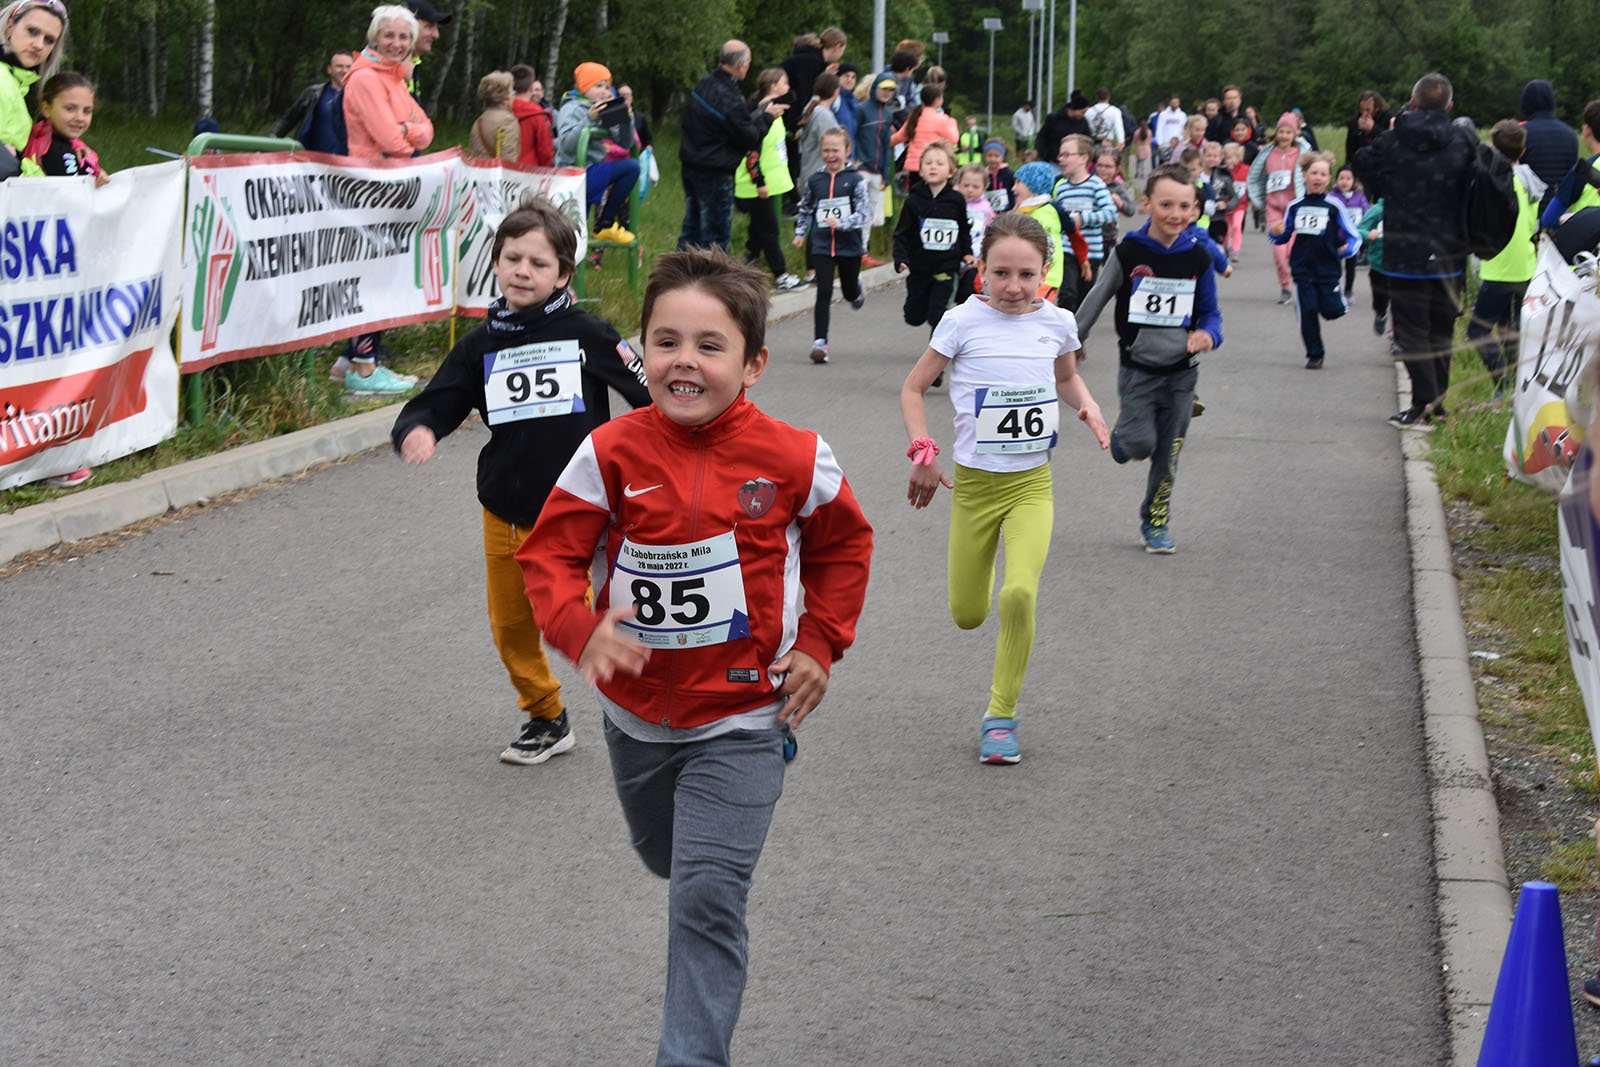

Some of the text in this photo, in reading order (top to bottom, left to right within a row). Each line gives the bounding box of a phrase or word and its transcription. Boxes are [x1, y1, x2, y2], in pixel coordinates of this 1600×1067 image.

[823, 207, 842, 219] 79
[1301, 216, 1318, 228] 18
[924, 229, 953, 244] 101
[0, 219, 76, 280] SKA
[1146, 294, 1177, 315] 81
[506, 367, 560, 403] 95
[997, 407, 1044, 439] 46
[631, 547, 688, 560] Zabobrzańska
[691, 546, 711, 557] Mila
[637, 560, 646, 569] 28
[646, 562, 664, 570] maja
[665, 561, 683, 570] 2022
[631, 577, 710, 626] 85
